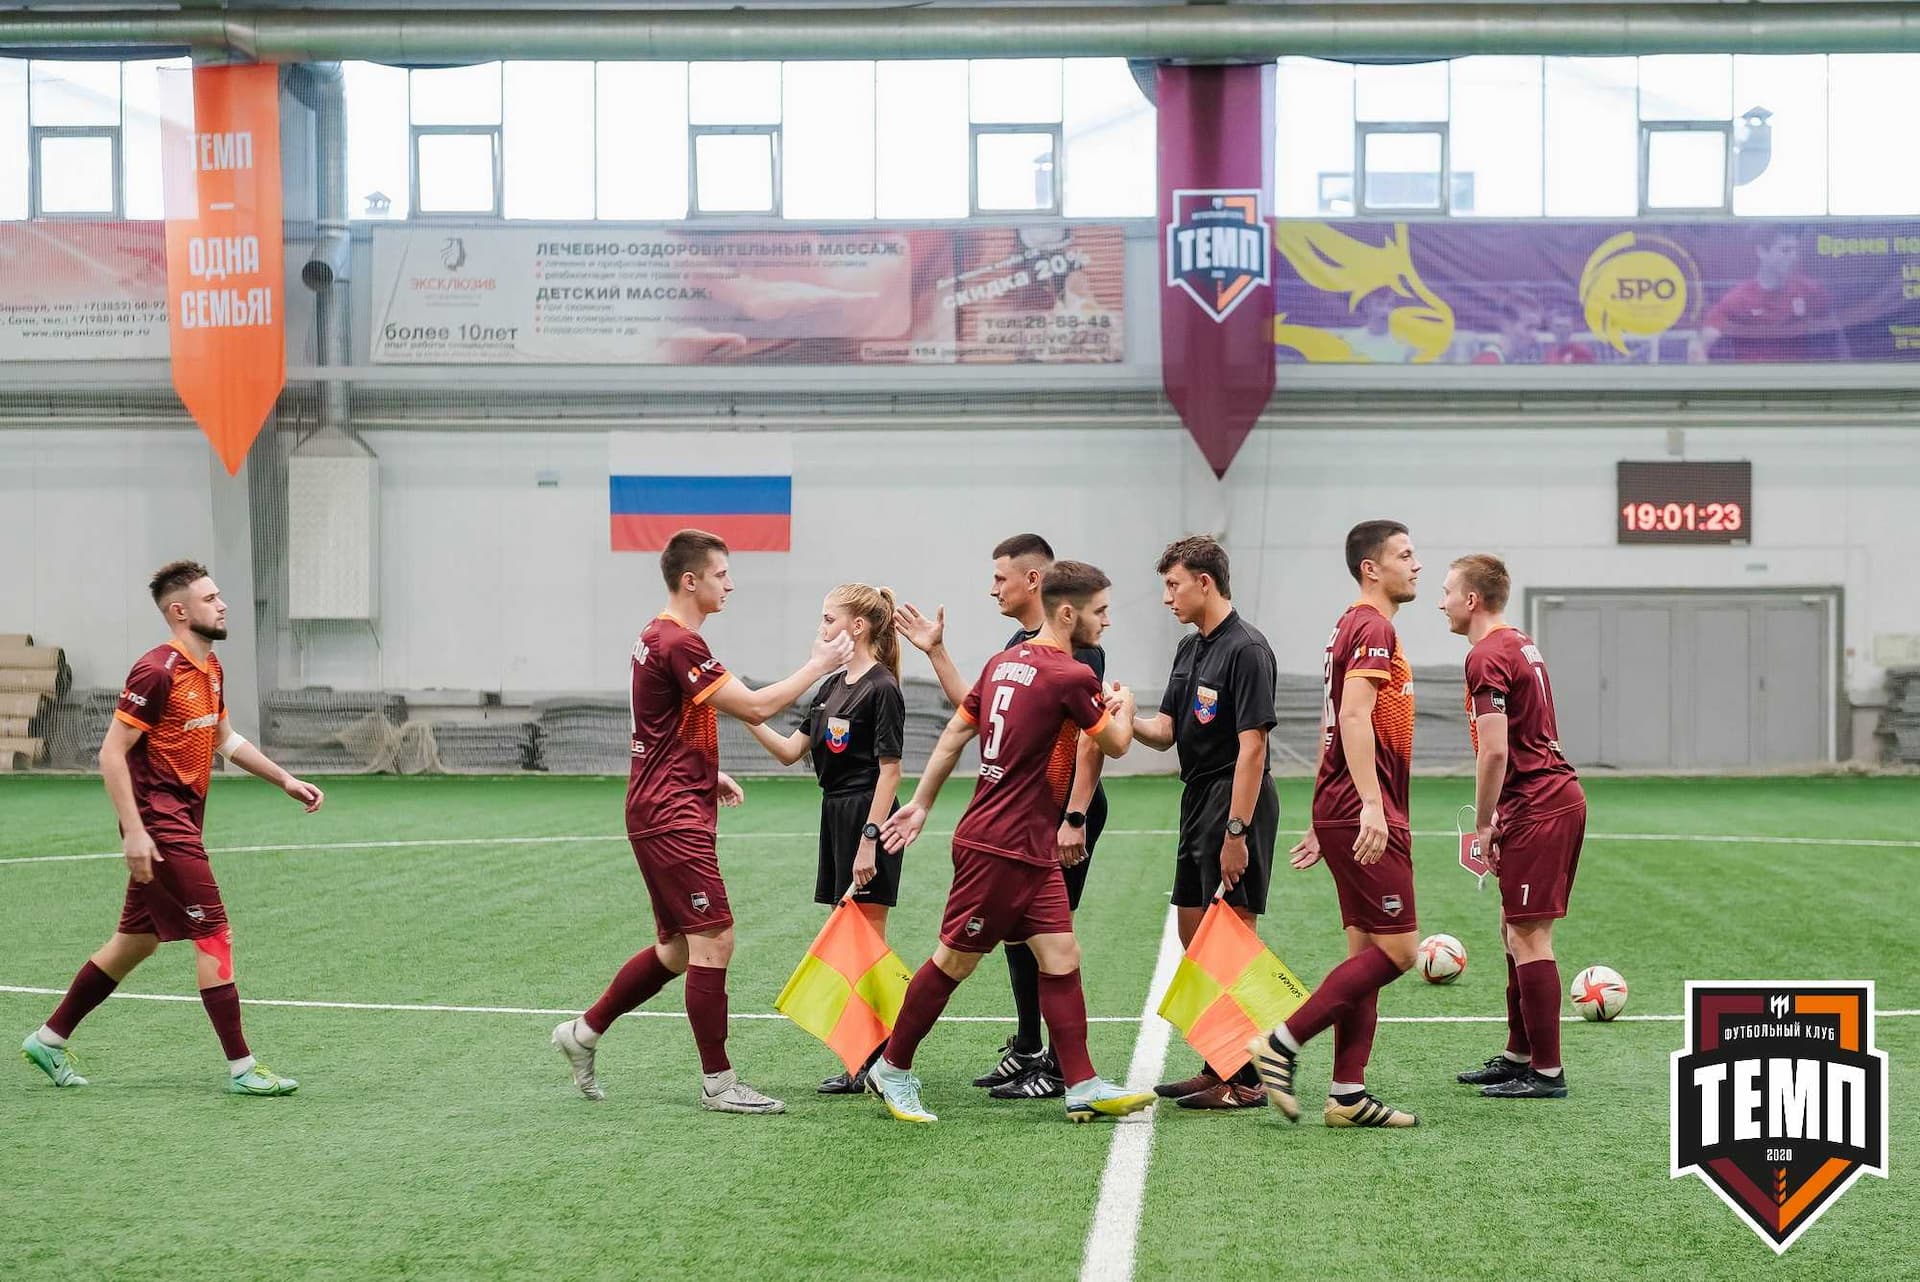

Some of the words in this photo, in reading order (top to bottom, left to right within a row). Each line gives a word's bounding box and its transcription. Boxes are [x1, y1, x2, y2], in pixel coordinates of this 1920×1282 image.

[186, 132, 252, 171] ТЕМП
[189, 235, 259, 282] ОДНА
[536, 241, 811, 258] ЛЕЧЕБНО-ОЗДОРОВИТЕЛЬНЫЙ
[1177, 226, 1260, 272] ТЕМП
[180, 288, 272, 329] СЕМЬЯ!
[536, 285, 620, 301] ДЕТСКИЙ
[627, 287, 712, 301] МАССАЖ:
[385, 323, 449, 341] более
[1622, 502, 1743, 531] 19:01:23
[983, 686, 1016, 760] 5
[1520, 883, 1530, 907] 7
